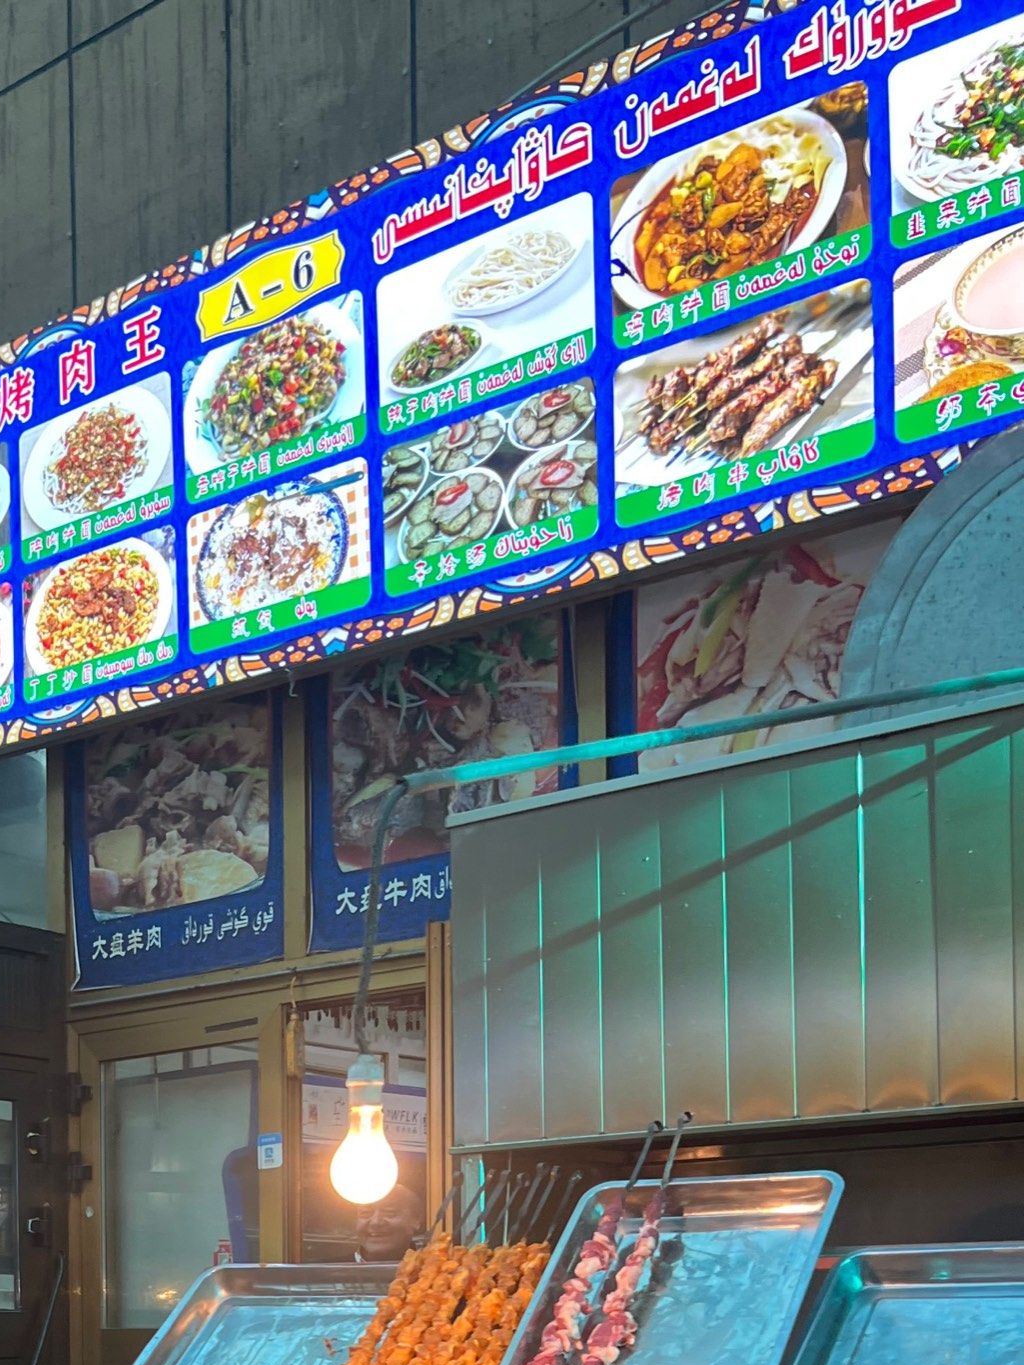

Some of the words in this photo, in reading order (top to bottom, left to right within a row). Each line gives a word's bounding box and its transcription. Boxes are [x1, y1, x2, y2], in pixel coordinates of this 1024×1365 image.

[907, 176, 1021, 240] 韭菜拌面
[936, 382, 1005, 432] 奶茶
[657, 463, 749, 510] 烤肉串
[92, 925, 162, 960] 大盘羊肉
